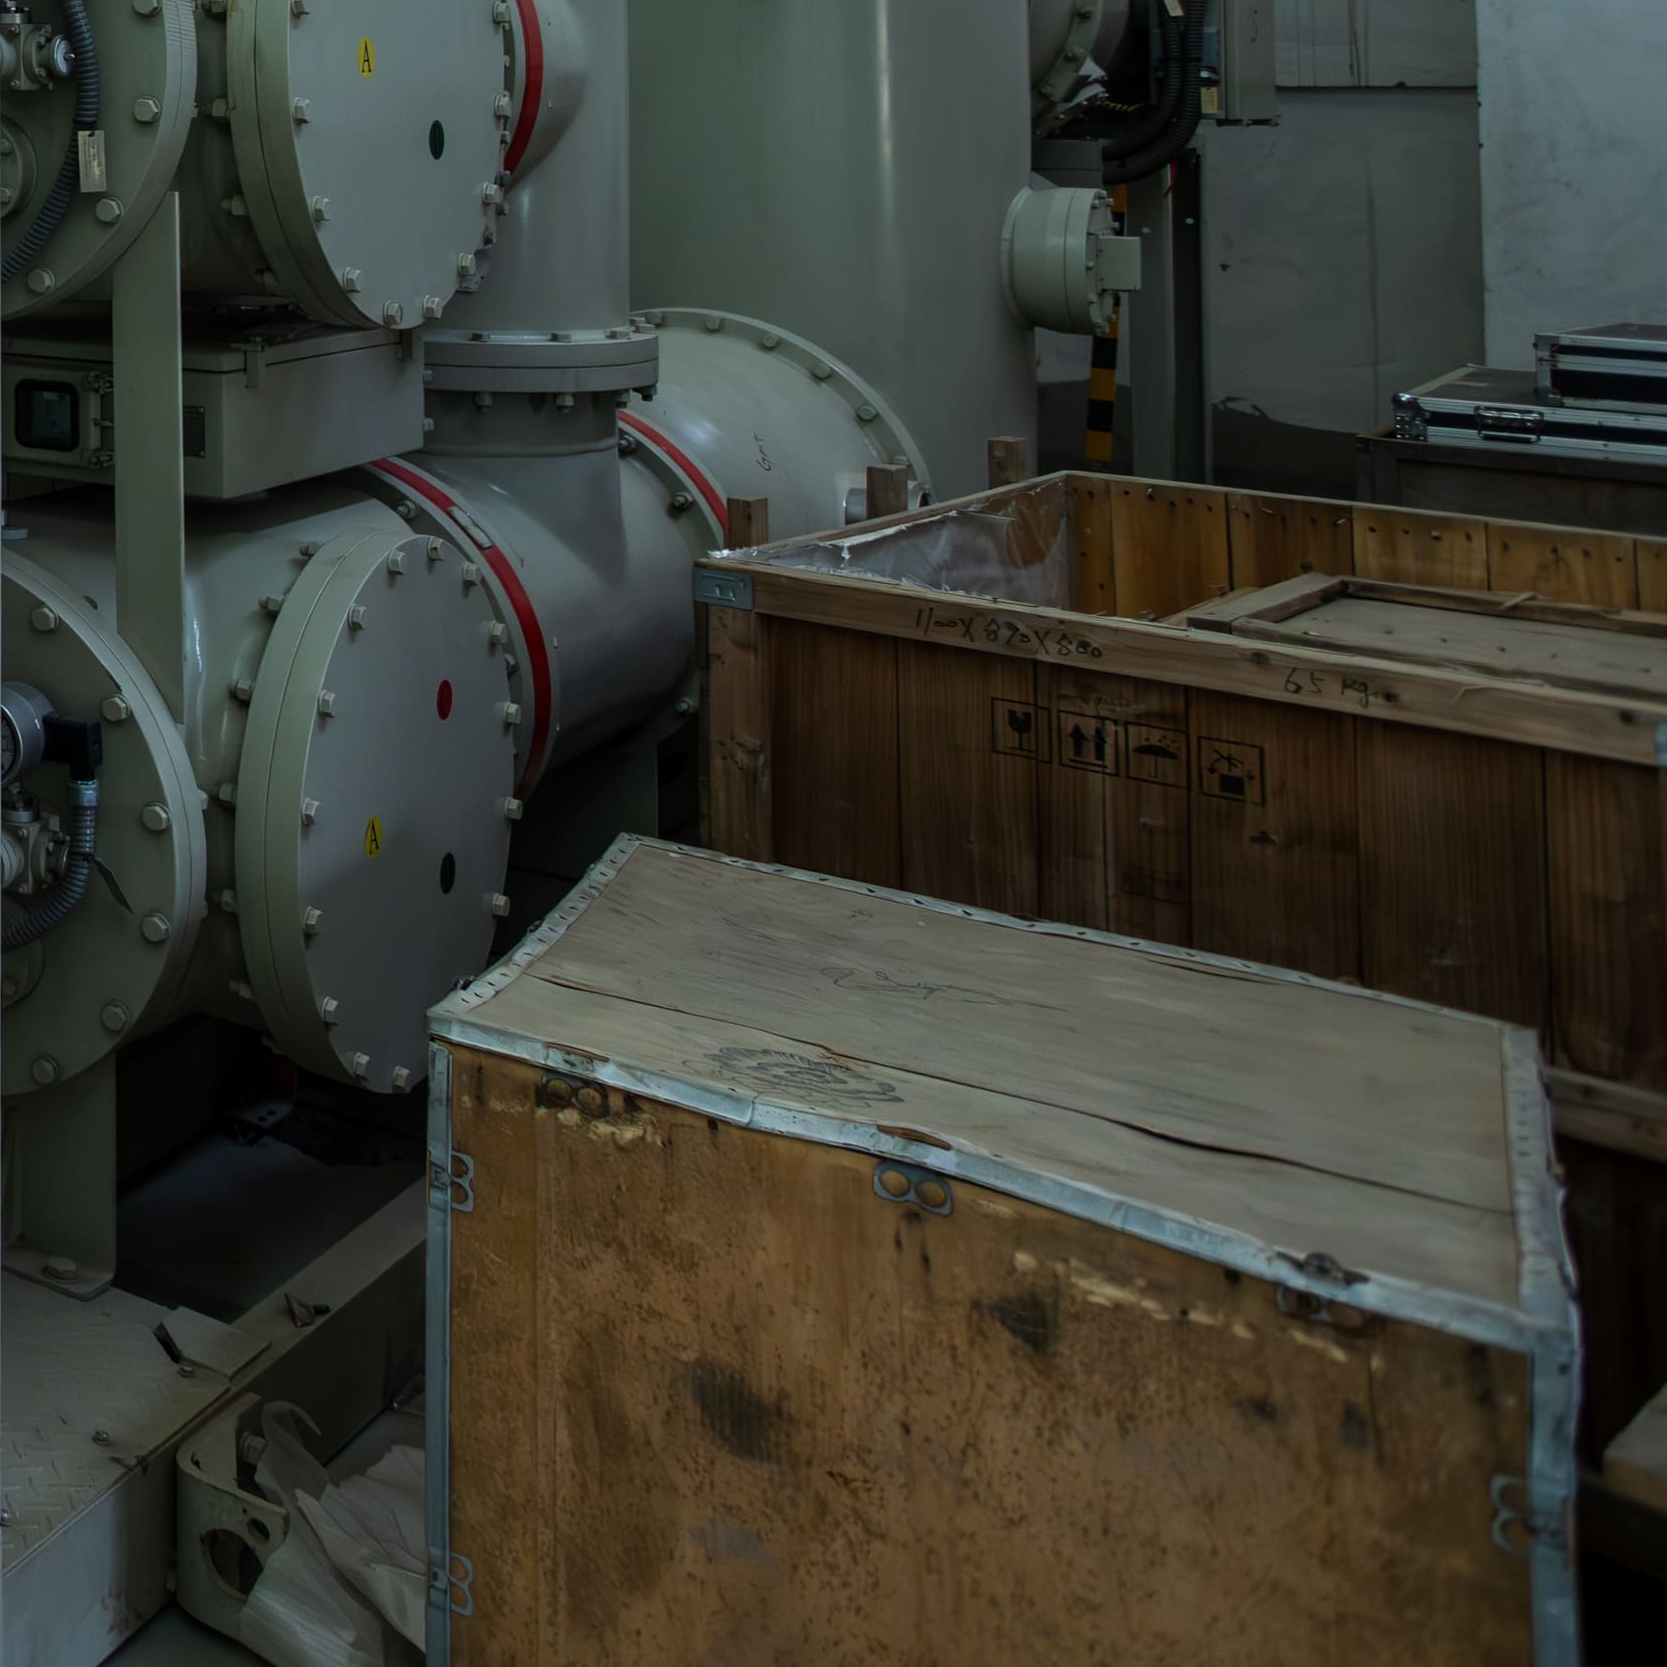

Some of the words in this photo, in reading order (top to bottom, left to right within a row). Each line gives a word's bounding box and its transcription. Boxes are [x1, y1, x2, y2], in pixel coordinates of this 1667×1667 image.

[361, 39, 372, 73] A
[1284, 668, 1324, 694] 65
[367, 818, 380, 856] A
